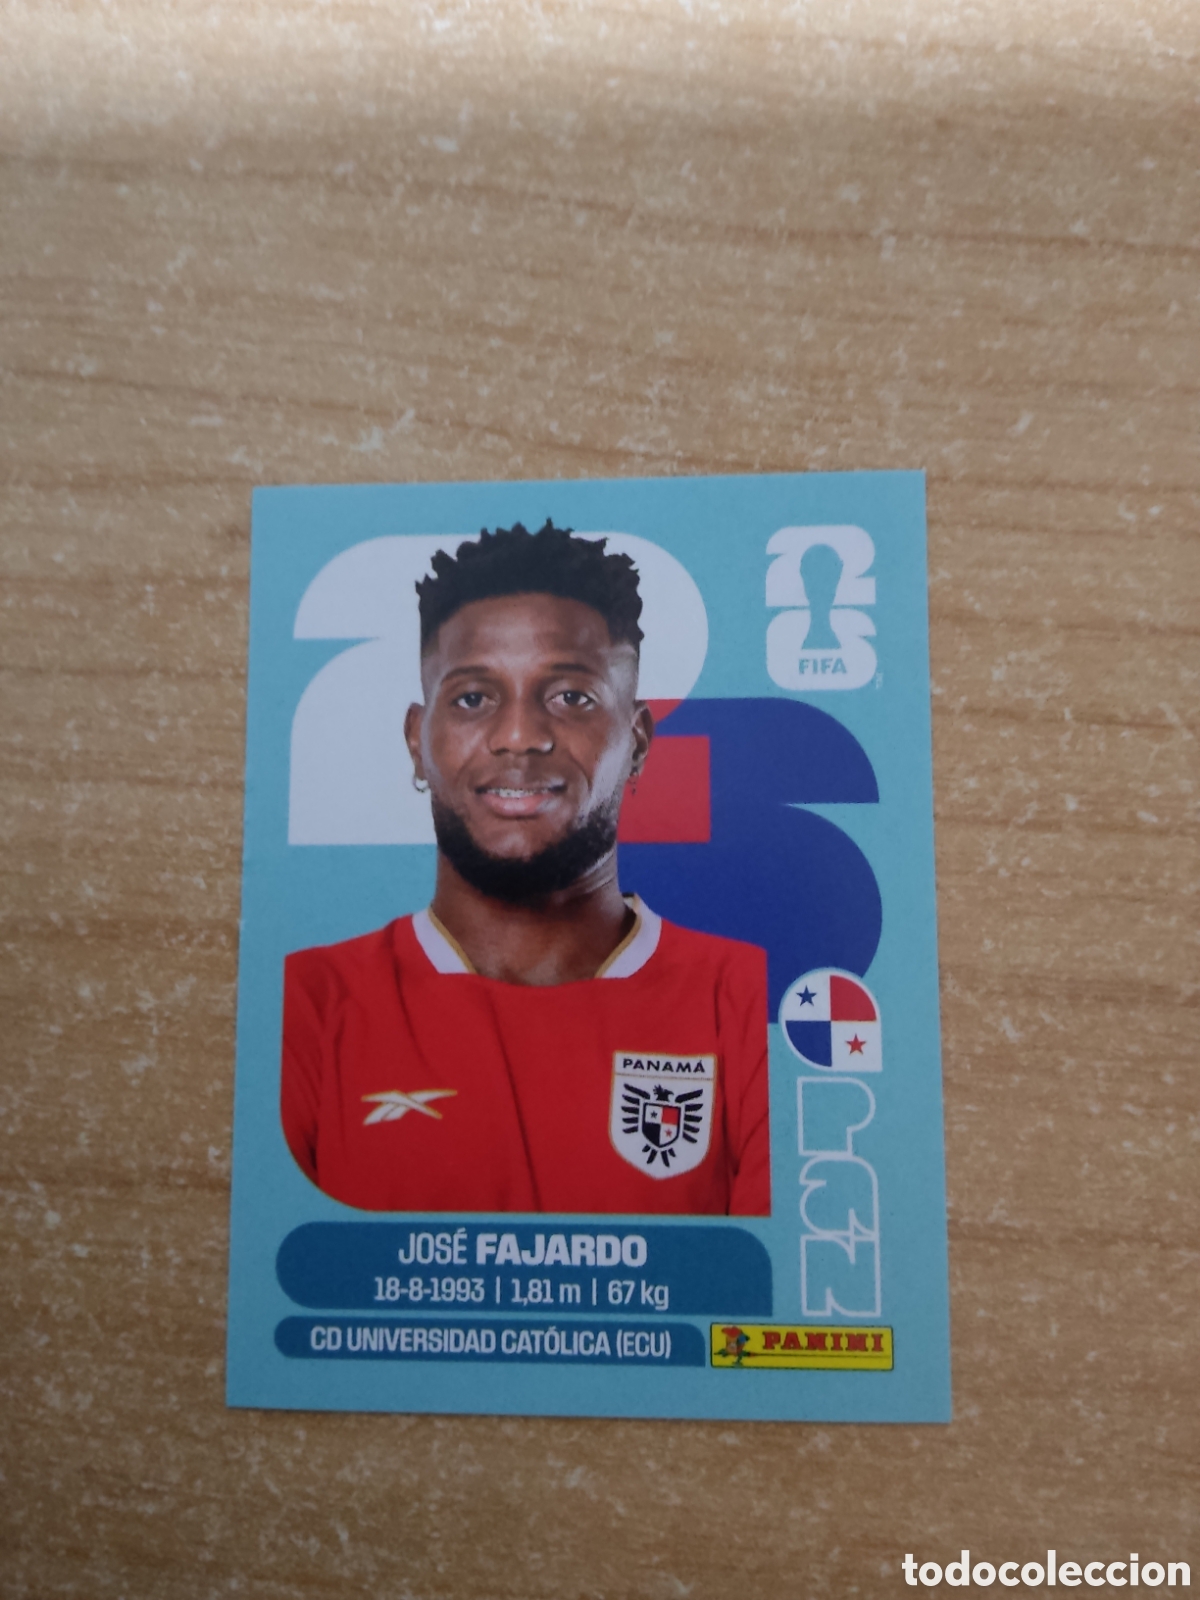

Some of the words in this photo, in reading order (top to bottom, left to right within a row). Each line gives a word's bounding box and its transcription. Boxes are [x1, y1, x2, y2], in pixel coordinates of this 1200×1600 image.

[799, 658, 847, 675] FIFA
[622, 1058, 706, 1074] PANAMÁ
[398, 1228, 468, 1265] JOSÉ
[475, 1232, 648, 1267] FAJARDO
[374, 1276, 485, 1302] 18-8-1993
[511, 1278, 554, 1307] 1,81
[558, 1283, 581, 1304] m
[607, 1280, 635, 1304] 67
[640, 1280, 669, 1311] kg
[310, 1326, 343, 1351] CD
[347, 1327, 496, 1354] UNIVERSIDAD
[500, 1326, 612, 1356] CATÓLICA
[615, 1329, 672, 1359] (ECU)
[762, 1331, 884, 1352] PANINI
